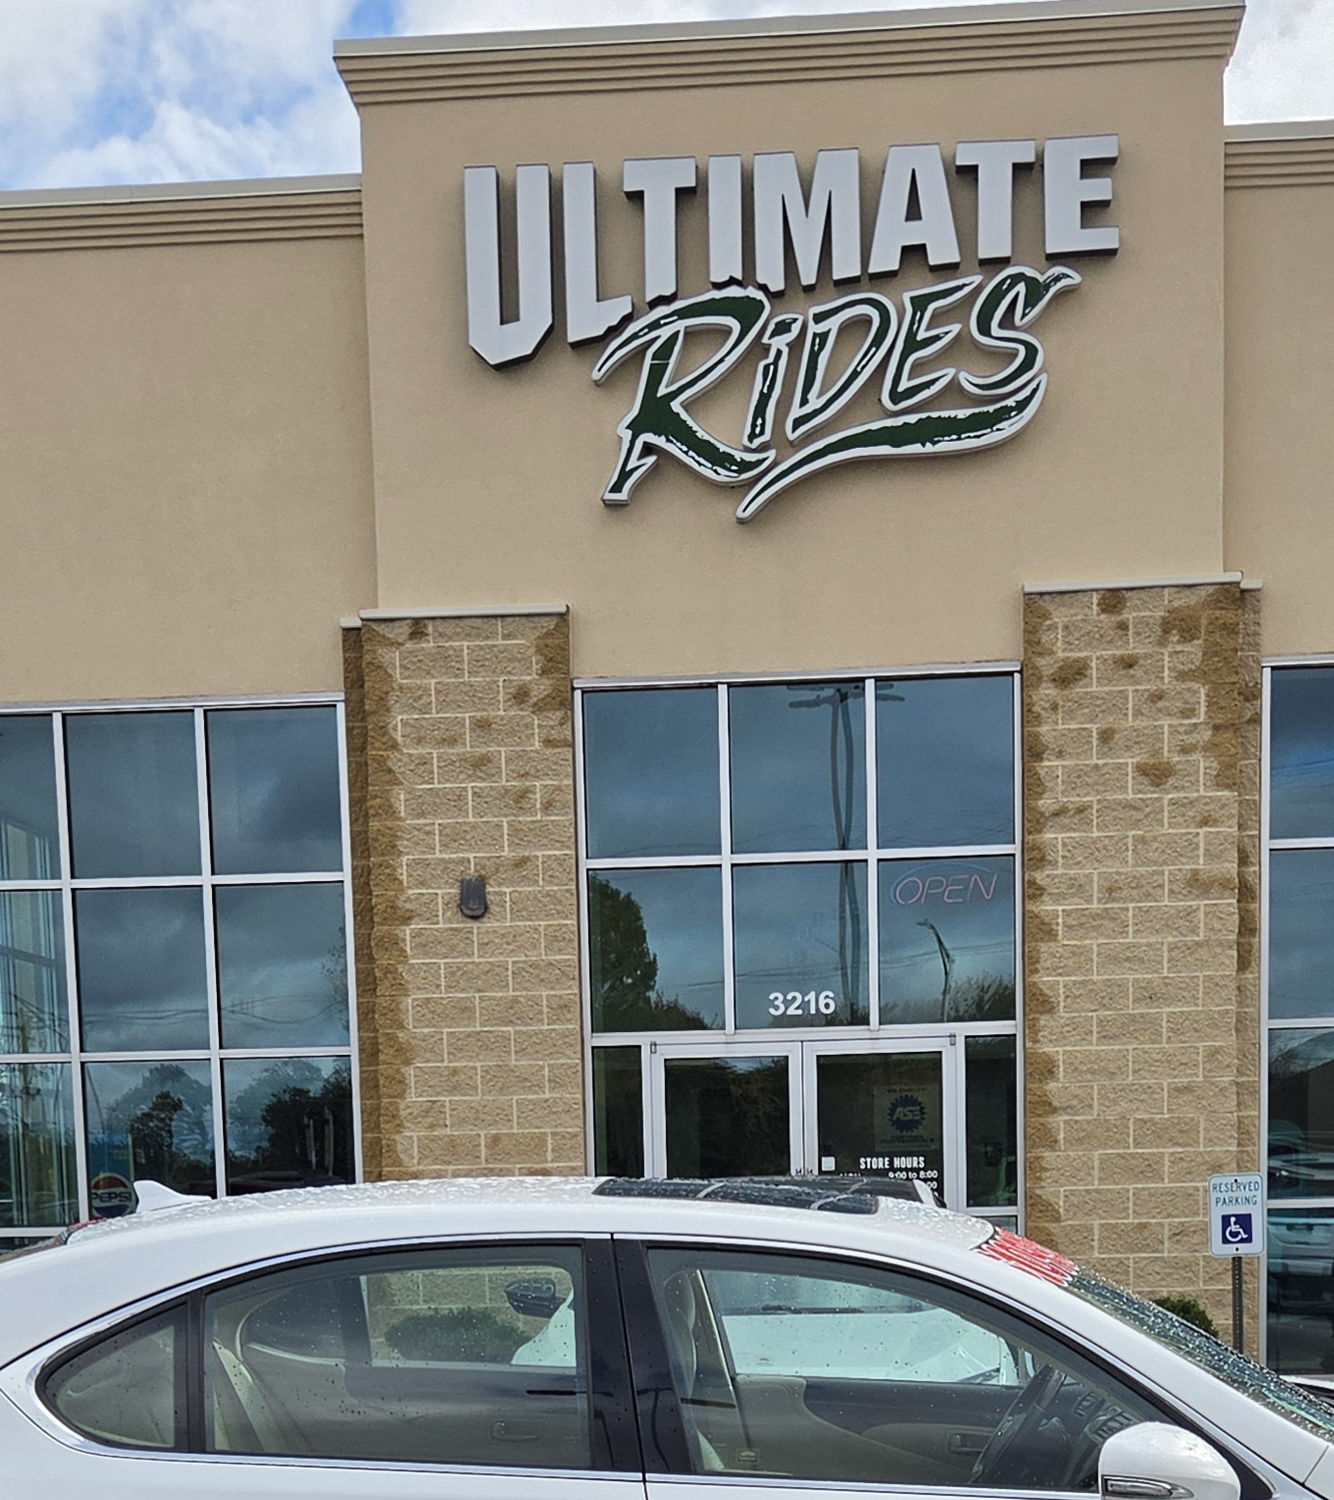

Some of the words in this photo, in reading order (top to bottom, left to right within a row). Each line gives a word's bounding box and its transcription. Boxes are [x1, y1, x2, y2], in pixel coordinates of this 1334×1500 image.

[464, 134, 1120, 370] ULTIMATE
[895, 873, 998, 905] OPEN
[768, 990, 836, 1016] 3216
[892, 1106, 923, 1121] ASE
[859, 1157, 890, 1169] STORE
[893, 1156, 925, 1168] HOURS
[908, 1171, 918, 1179] to
[919, 1170, 938, 1179] 8:00
[1212, 1181, 1260, 1193] RESERVED
[92, 1191, 132, 1203] PEPSI
[1215, 1195, 1258, 1207] PARKING
